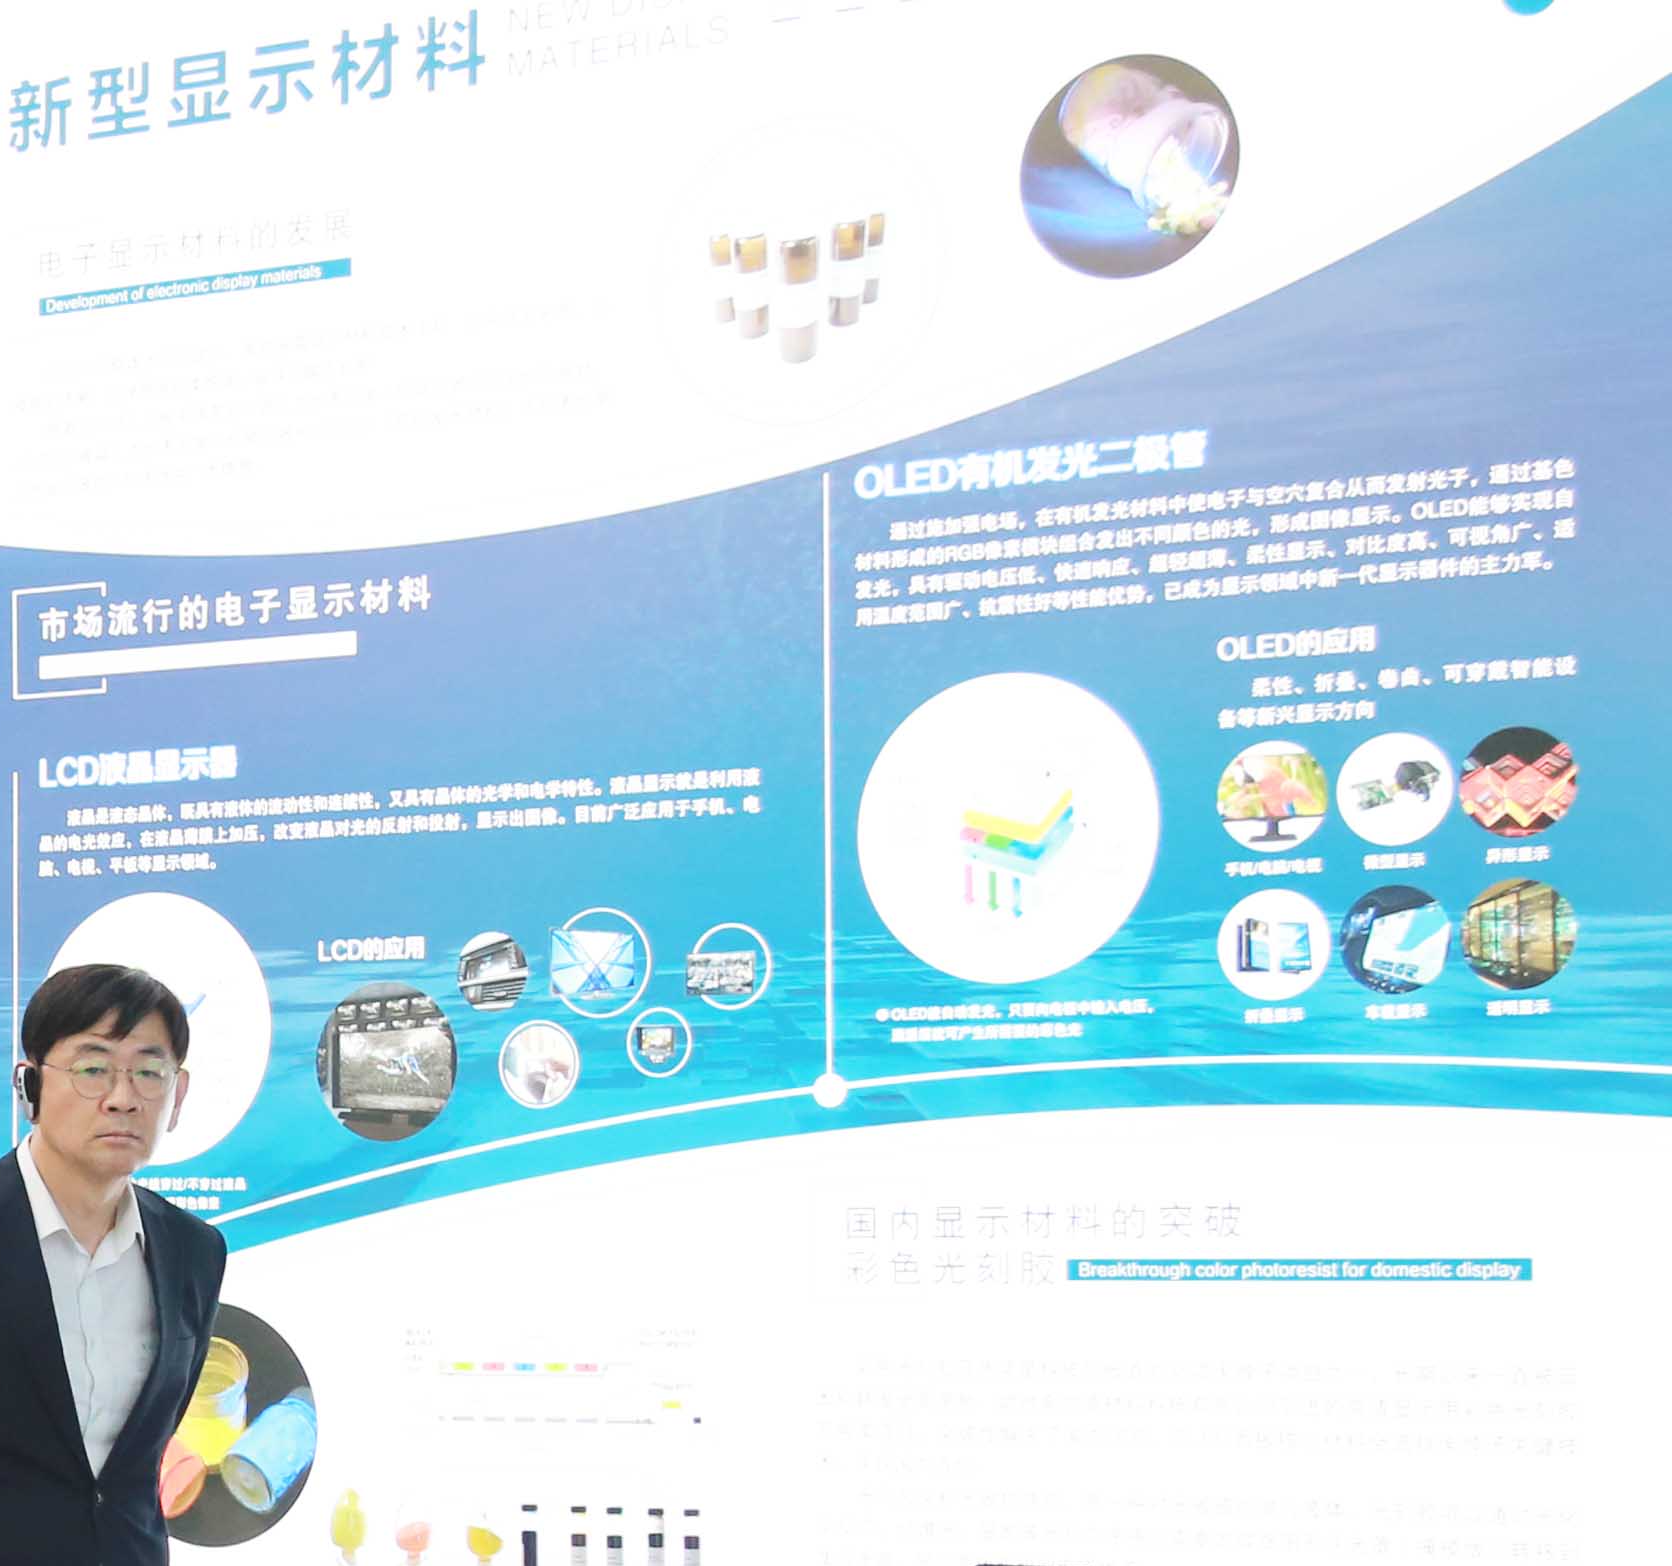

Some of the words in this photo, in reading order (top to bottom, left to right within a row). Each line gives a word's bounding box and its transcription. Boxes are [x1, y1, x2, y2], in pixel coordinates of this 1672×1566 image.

[8, 9, 487, 153] 新型显示材料
[45, 291, 129, 314] Development
[131, 285, 145, 302] of
[147, 280, 210, 300] electronic
[211, 272, 259, 293] display
[260, 264, 323, 285] materials
[855, 430, 1208, 499] OLED有机发光二极管
[39, 574, 432, 643] 市场流行的电子显示材料
[1216, 625, 1377, 662] OLED的应用
[38, 744, 238, 789] LCD液晶显示器
[317, 936, 426, 963] LCD的应用
[845, 1201, 1242, 1241] 国内显示材料的突破
[1078, 1260, 1191, 1280] Breakthrough
[1194, 1260, 1235, 1278] color
[1241, 1260, 1337, 1280] photoresist
[1341, 1260, 1367, 1278] for
[1370, 1260, 1453, 1278] domestic
[1457, 1260, 1521, 1281] display
